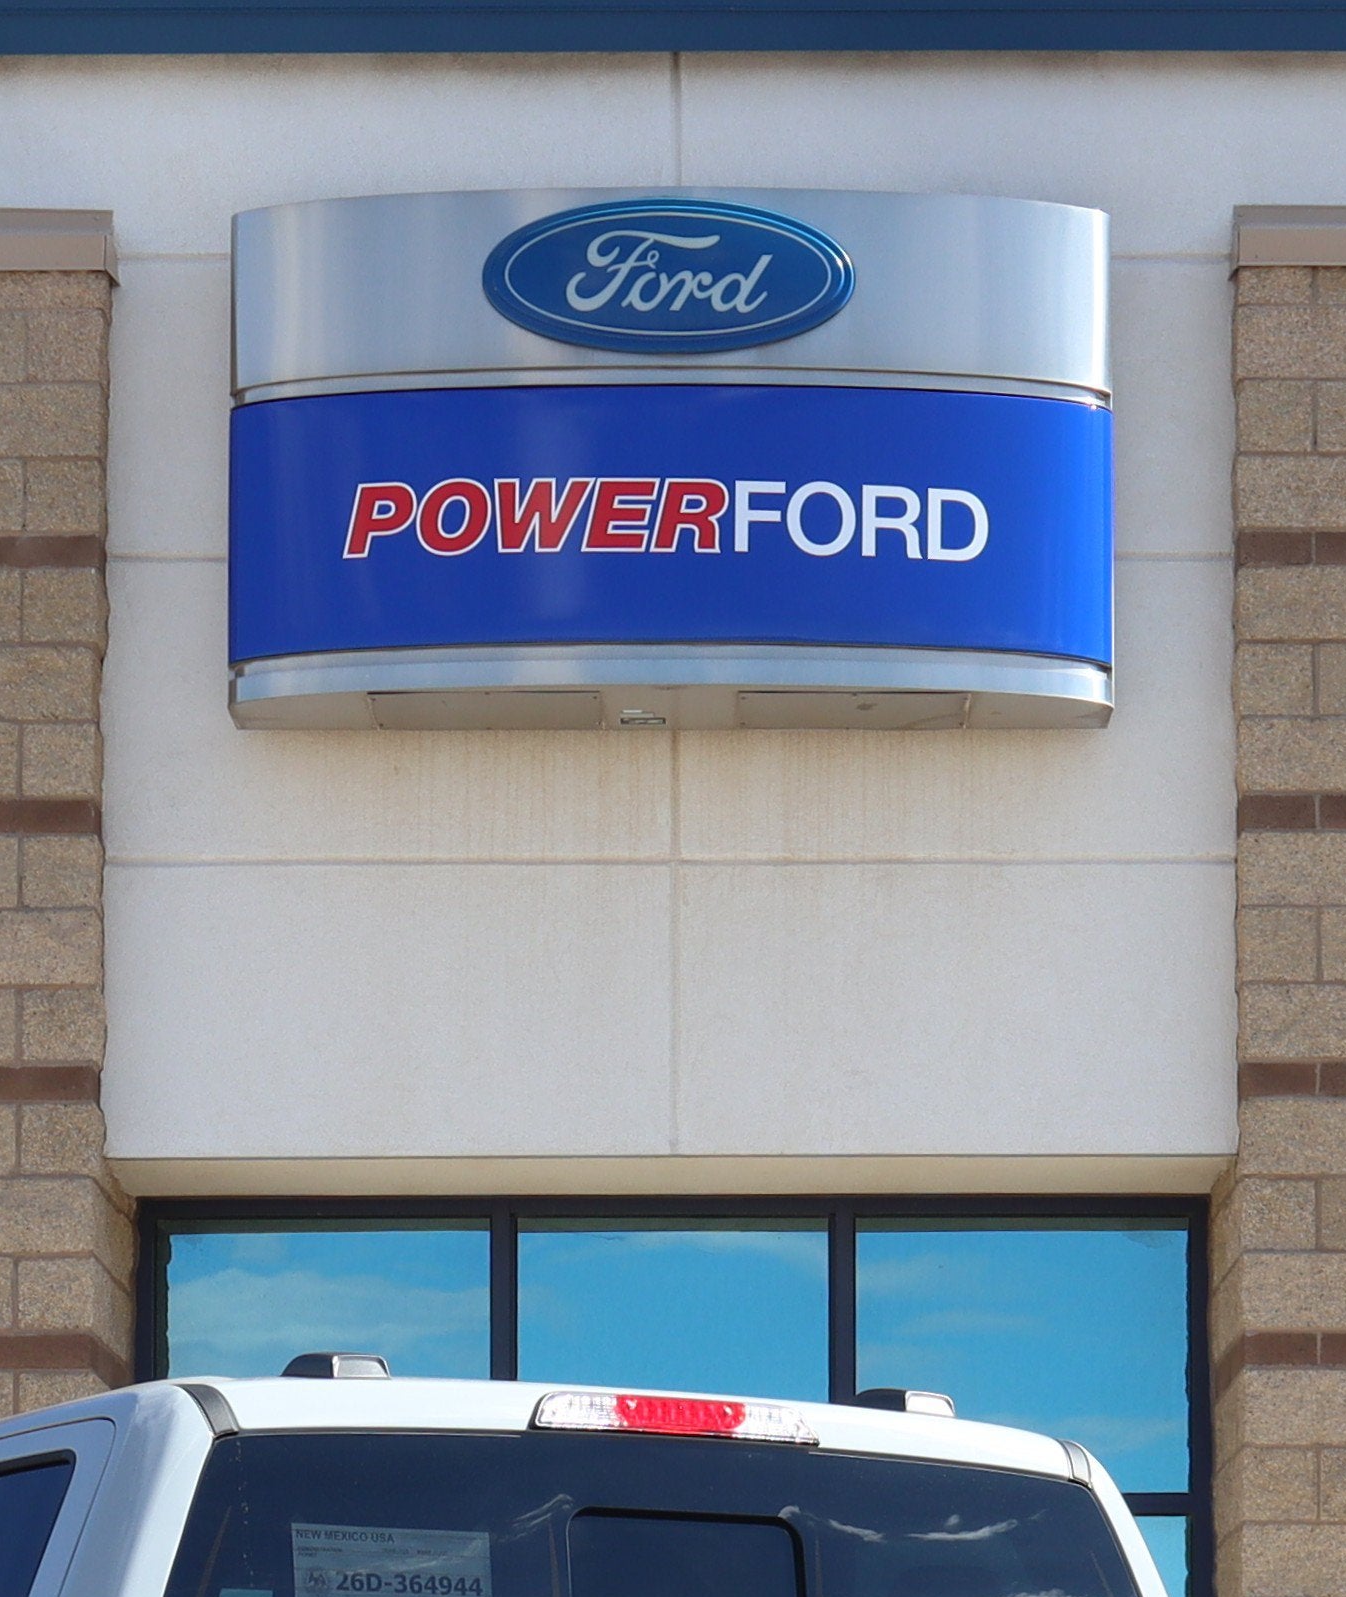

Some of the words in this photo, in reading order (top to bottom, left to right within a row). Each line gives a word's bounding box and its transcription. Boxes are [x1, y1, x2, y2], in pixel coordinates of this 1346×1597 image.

[565, 229, 769, 316] Ford
[342, 478, 990, 563] POWERFORD
[295, 1529, 321, 1540] NEW
[325, 1530, 368, 1542] MEXICO
[371, 1532, 395, 1544] USA
[336, 1572, 483, 1597] 26D-364944
